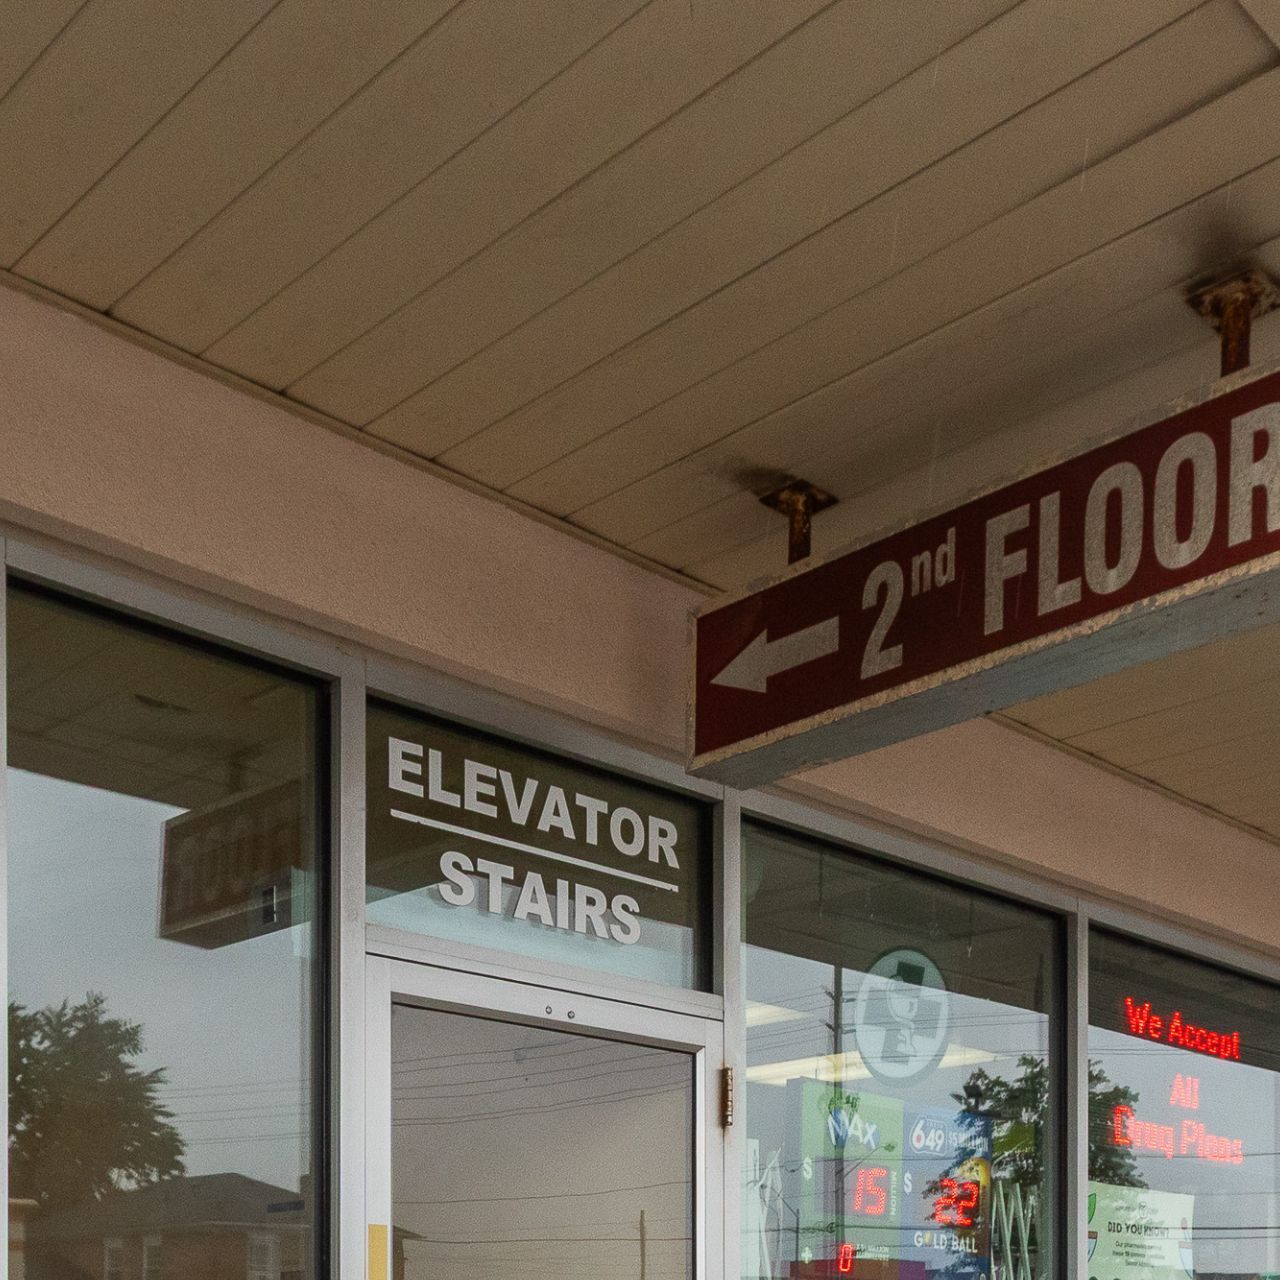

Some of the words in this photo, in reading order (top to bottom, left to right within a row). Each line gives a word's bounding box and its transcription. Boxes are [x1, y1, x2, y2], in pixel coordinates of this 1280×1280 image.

[859, 529, 957, 680] 2nd
[388, 736, 680, 869] ELEVATOR
[437, 850, 641, 945] STAIRS
[1125, 996, 1163, 1039] We
[1169, 1011, 1241, 1061] Accept
[1170, 1072, 1200, 1110] All
[912, 1119, 945, 1151] 649
[1113, 1105, 1175, 1159] Drug
[1180, 1119, 1244, 1165] Plans
[854, 1168, 887, 1215] 15
[934, 1178, 980, 1227] 22
